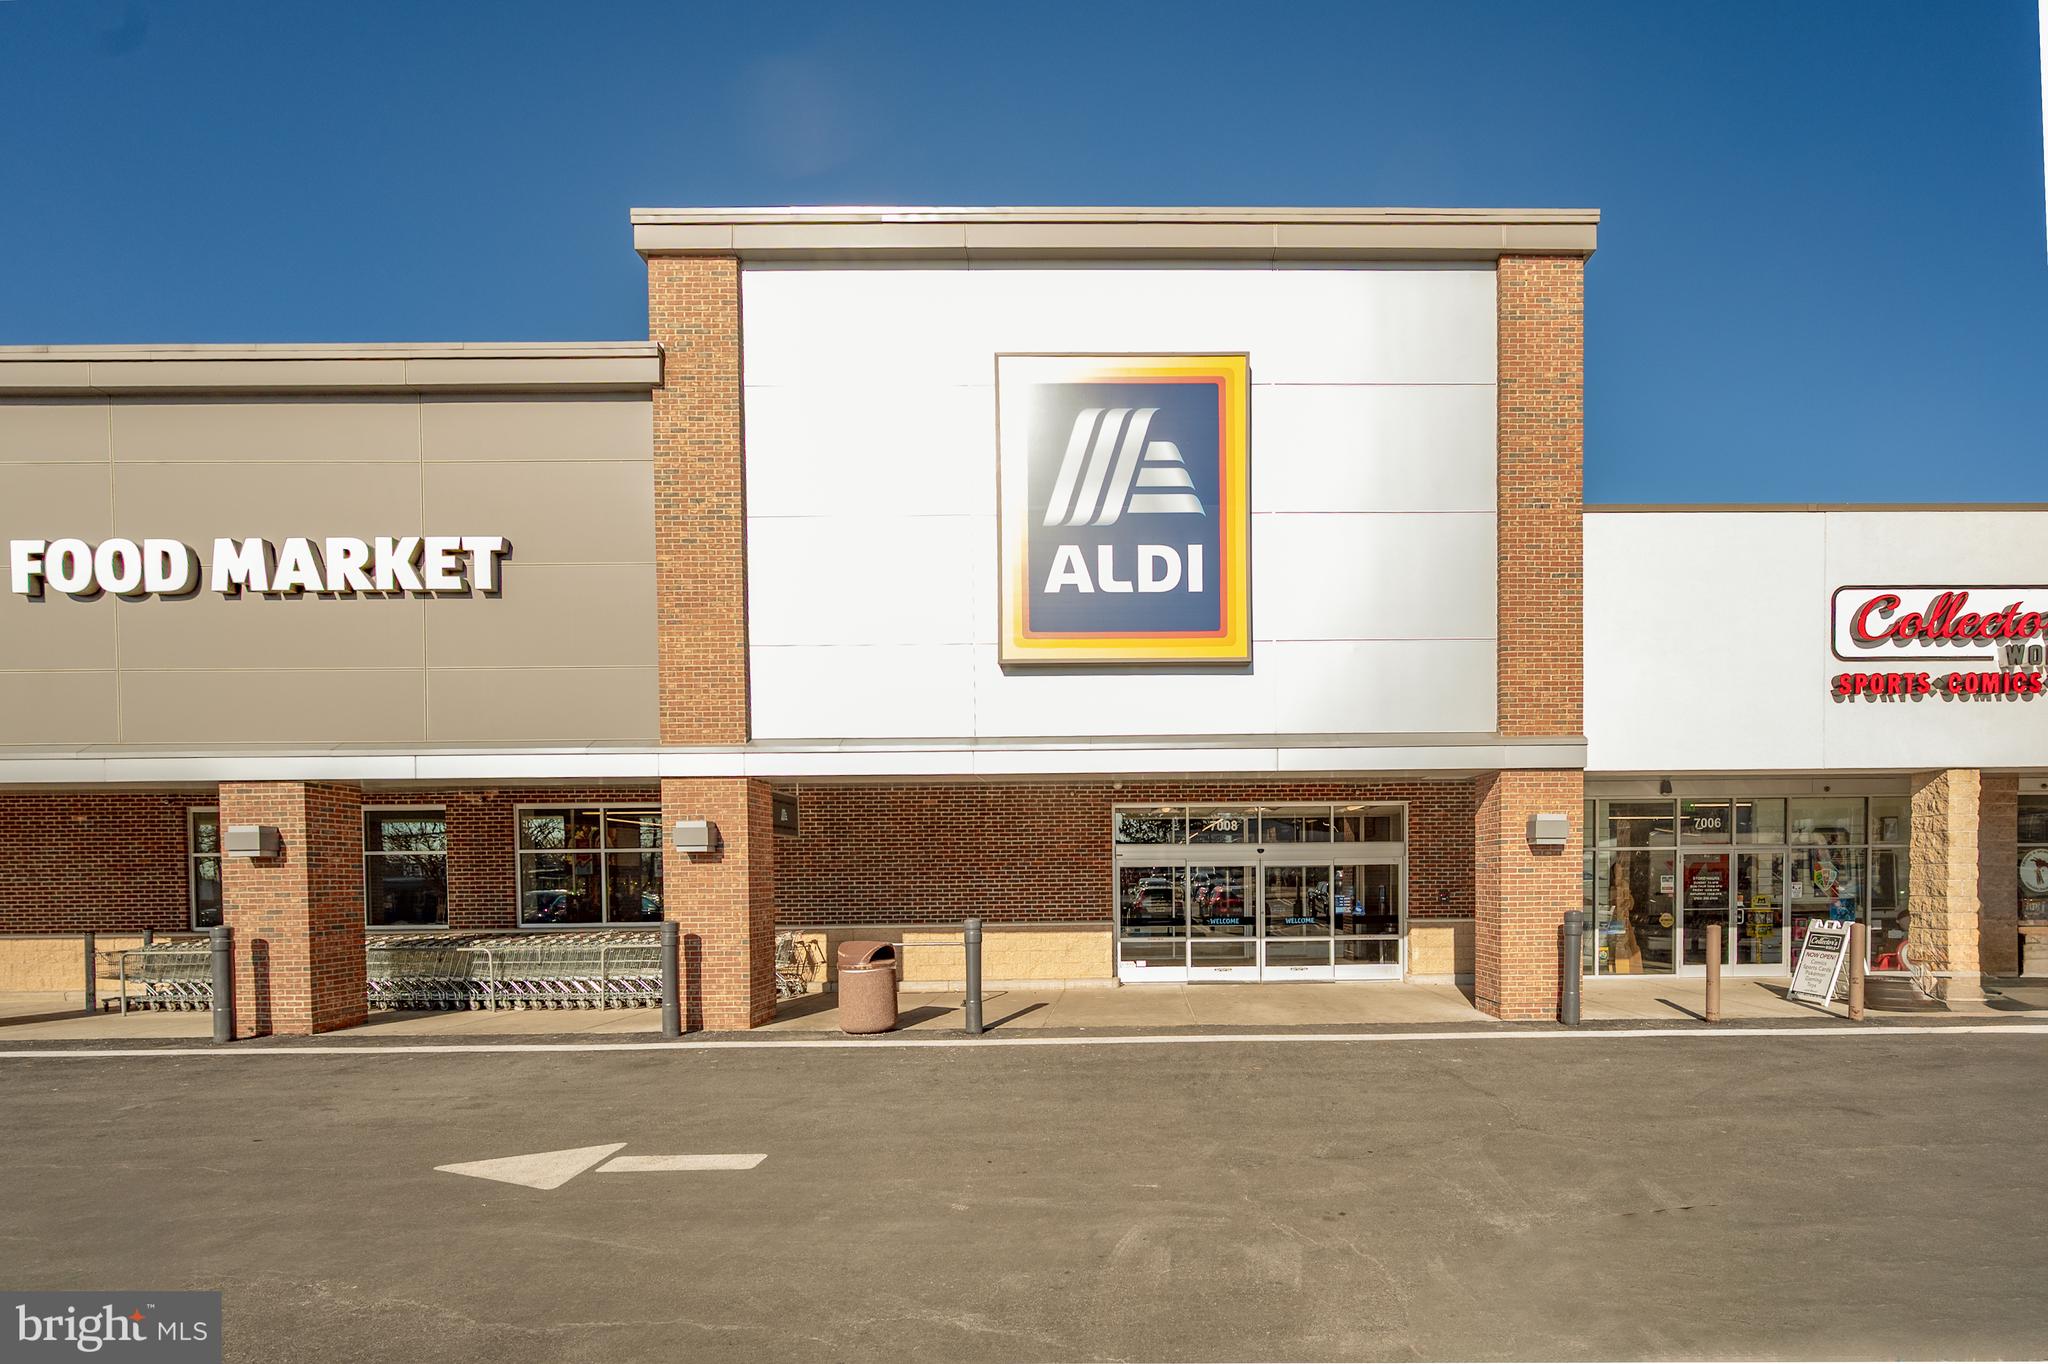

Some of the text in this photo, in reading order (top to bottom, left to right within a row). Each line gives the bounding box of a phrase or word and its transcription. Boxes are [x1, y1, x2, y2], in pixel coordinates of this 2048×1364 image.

[10, 536, 506, 595] FOOD MARKET
[1044, 544, 1204, 593] ALDI
[1855, 591, 2048, 640] Collecto
[2004, 644, 2048, 667] WO
[1837, 671, 2043, 696] SPORTS COMICS
[1210, 819, 1239, 832] 7008
[1693, 817, 1721, 829] 7006
[1210, 917, 1240, 925] WELCOME
